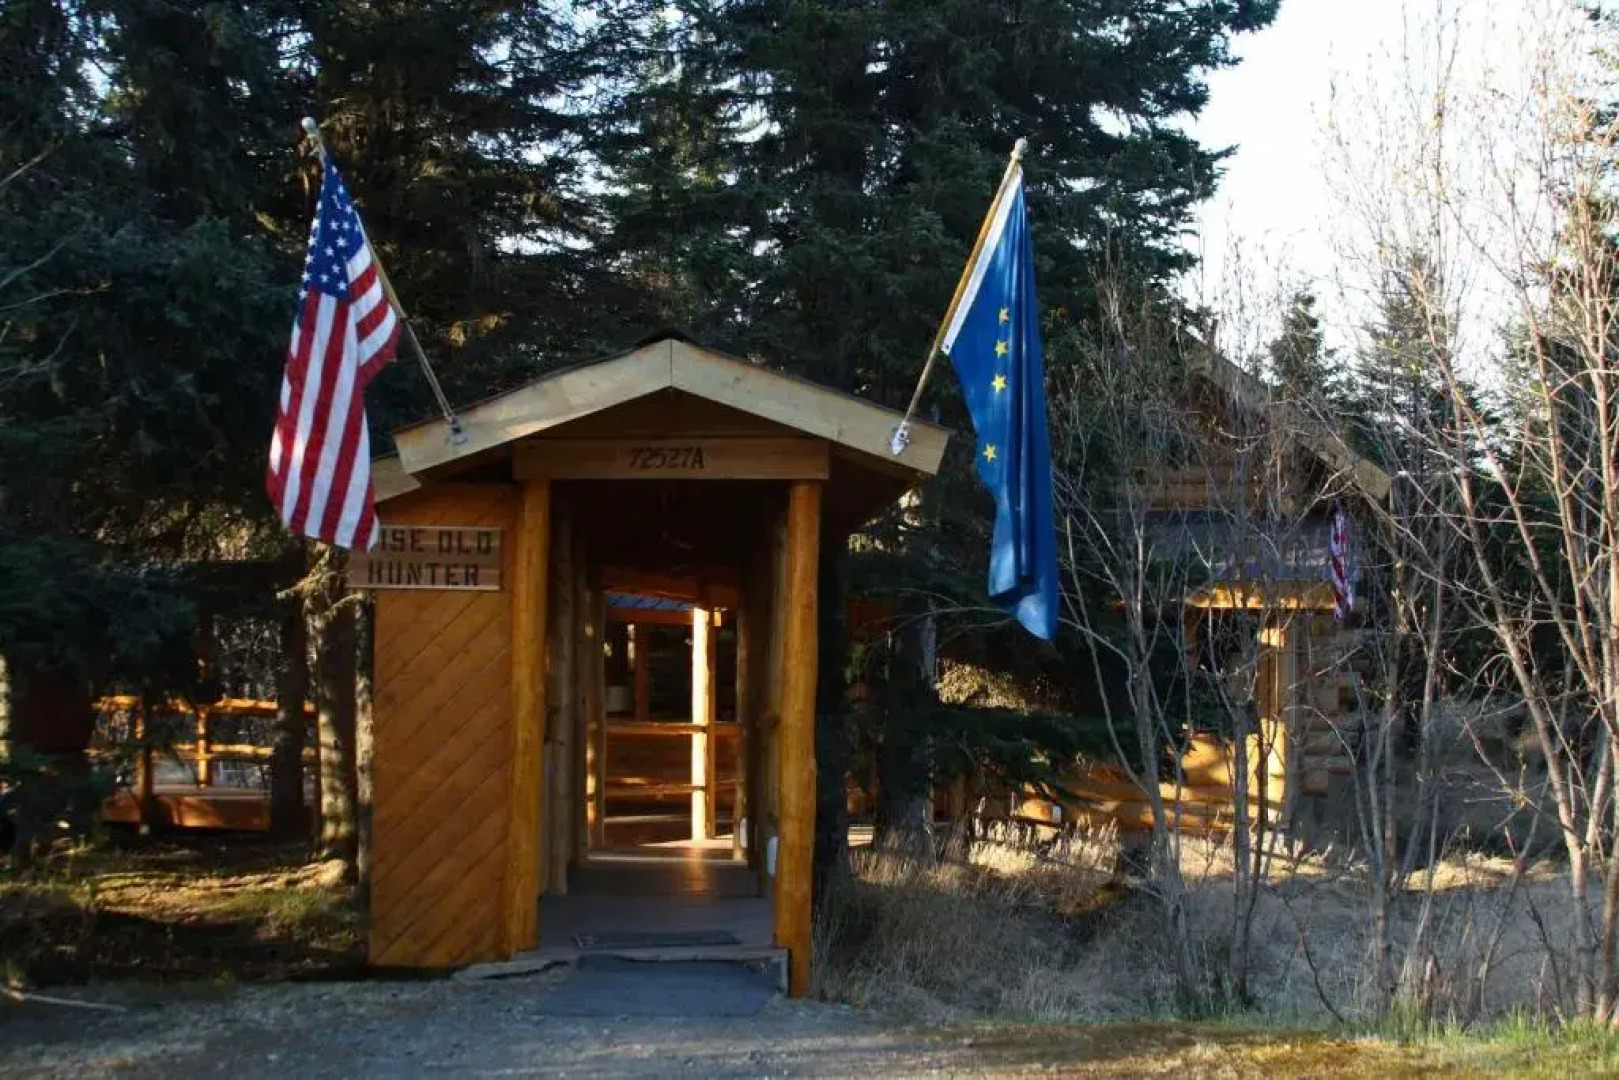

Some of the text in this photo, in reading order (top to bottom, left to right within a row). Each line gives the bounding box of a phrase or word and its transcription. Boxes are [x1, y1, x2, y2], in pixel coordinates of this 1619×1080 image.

[379, 529, 492, 555] ISE OLD
[368, 560, 479, 586] HUNTER
